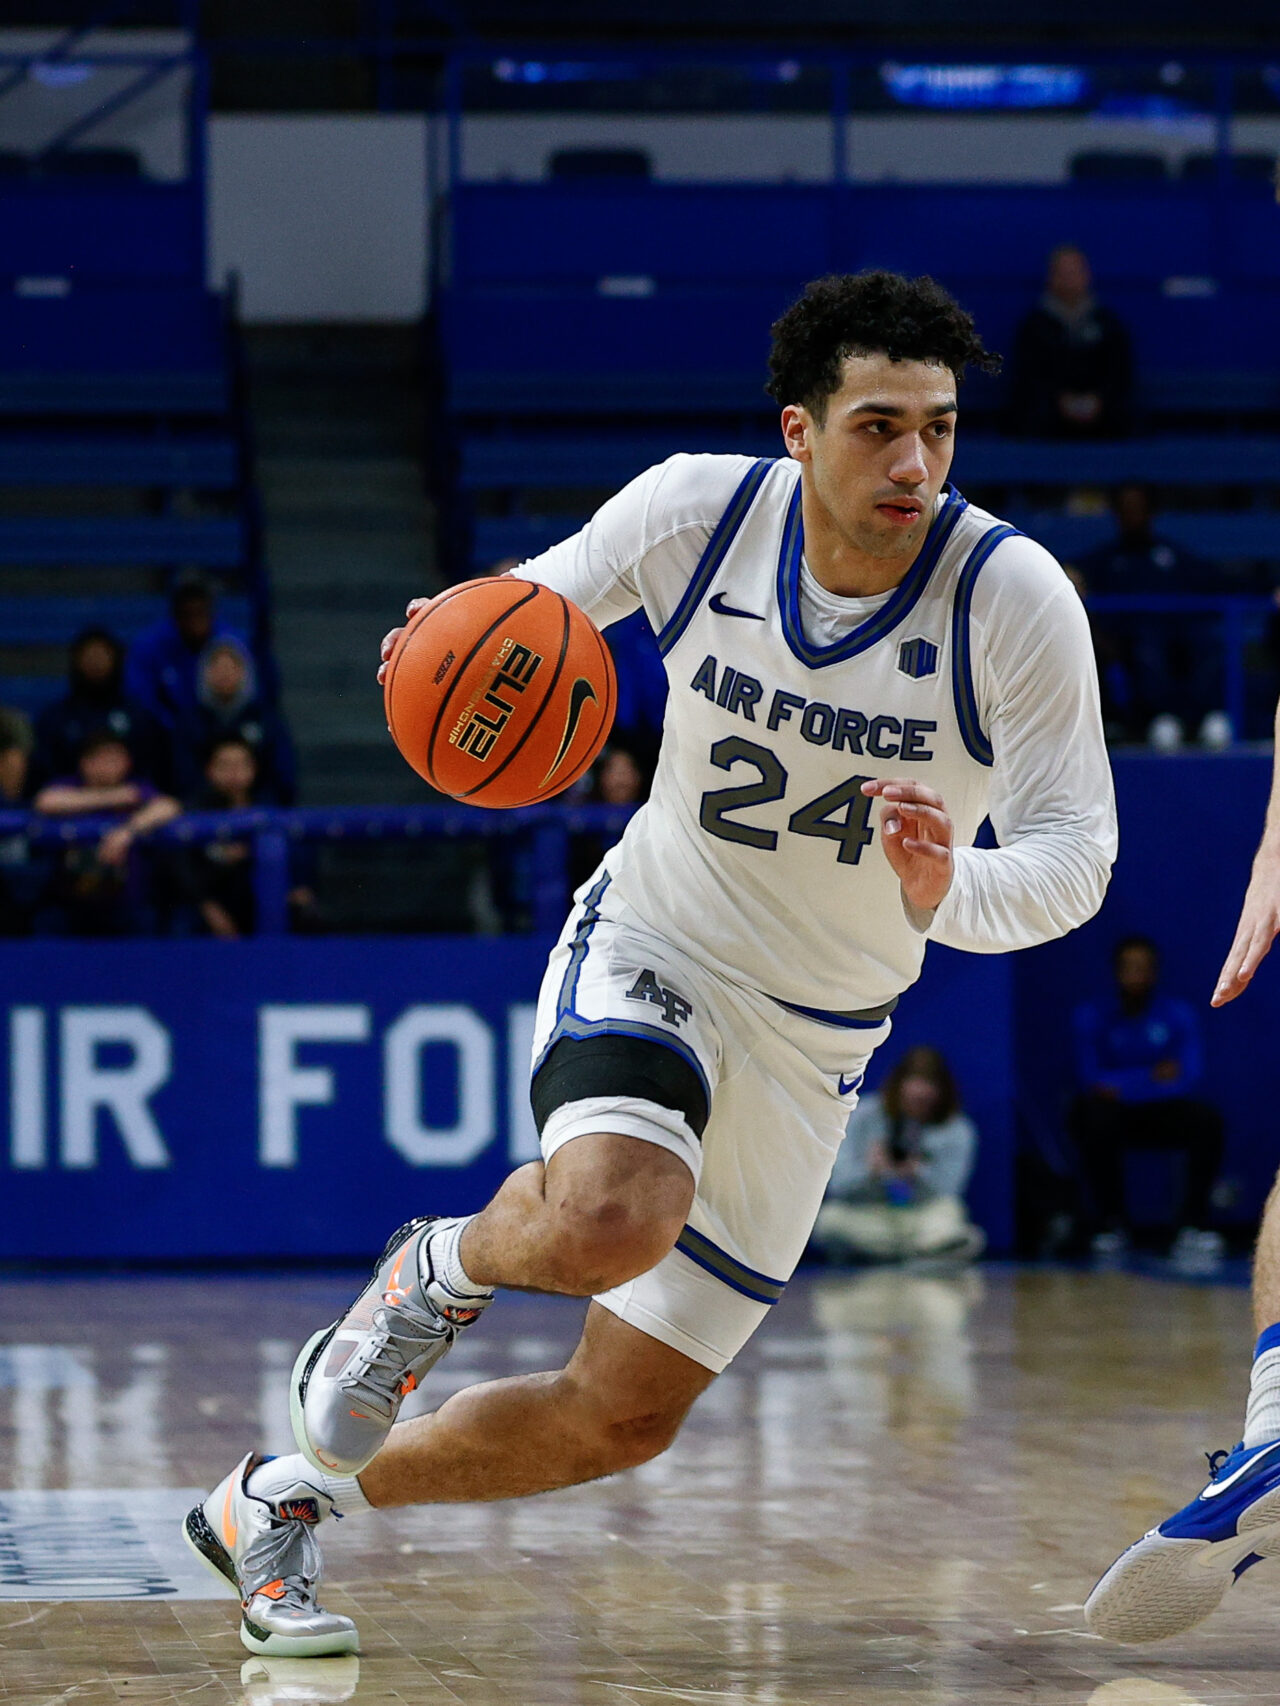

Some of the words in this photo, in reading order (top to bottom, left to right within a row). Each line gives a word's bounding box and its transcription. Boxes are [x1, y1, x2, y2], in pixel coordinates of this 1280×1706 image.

[448, 637, 515, 744] CHAIONSHIP
[455, 642, 545, 763] ELITE
[690, 654, 764, 723] AIR
[766, 689, 938, 762] FORCE
[699, 735, 878, 866] 24
[625, 968, 693, 1029] AF
